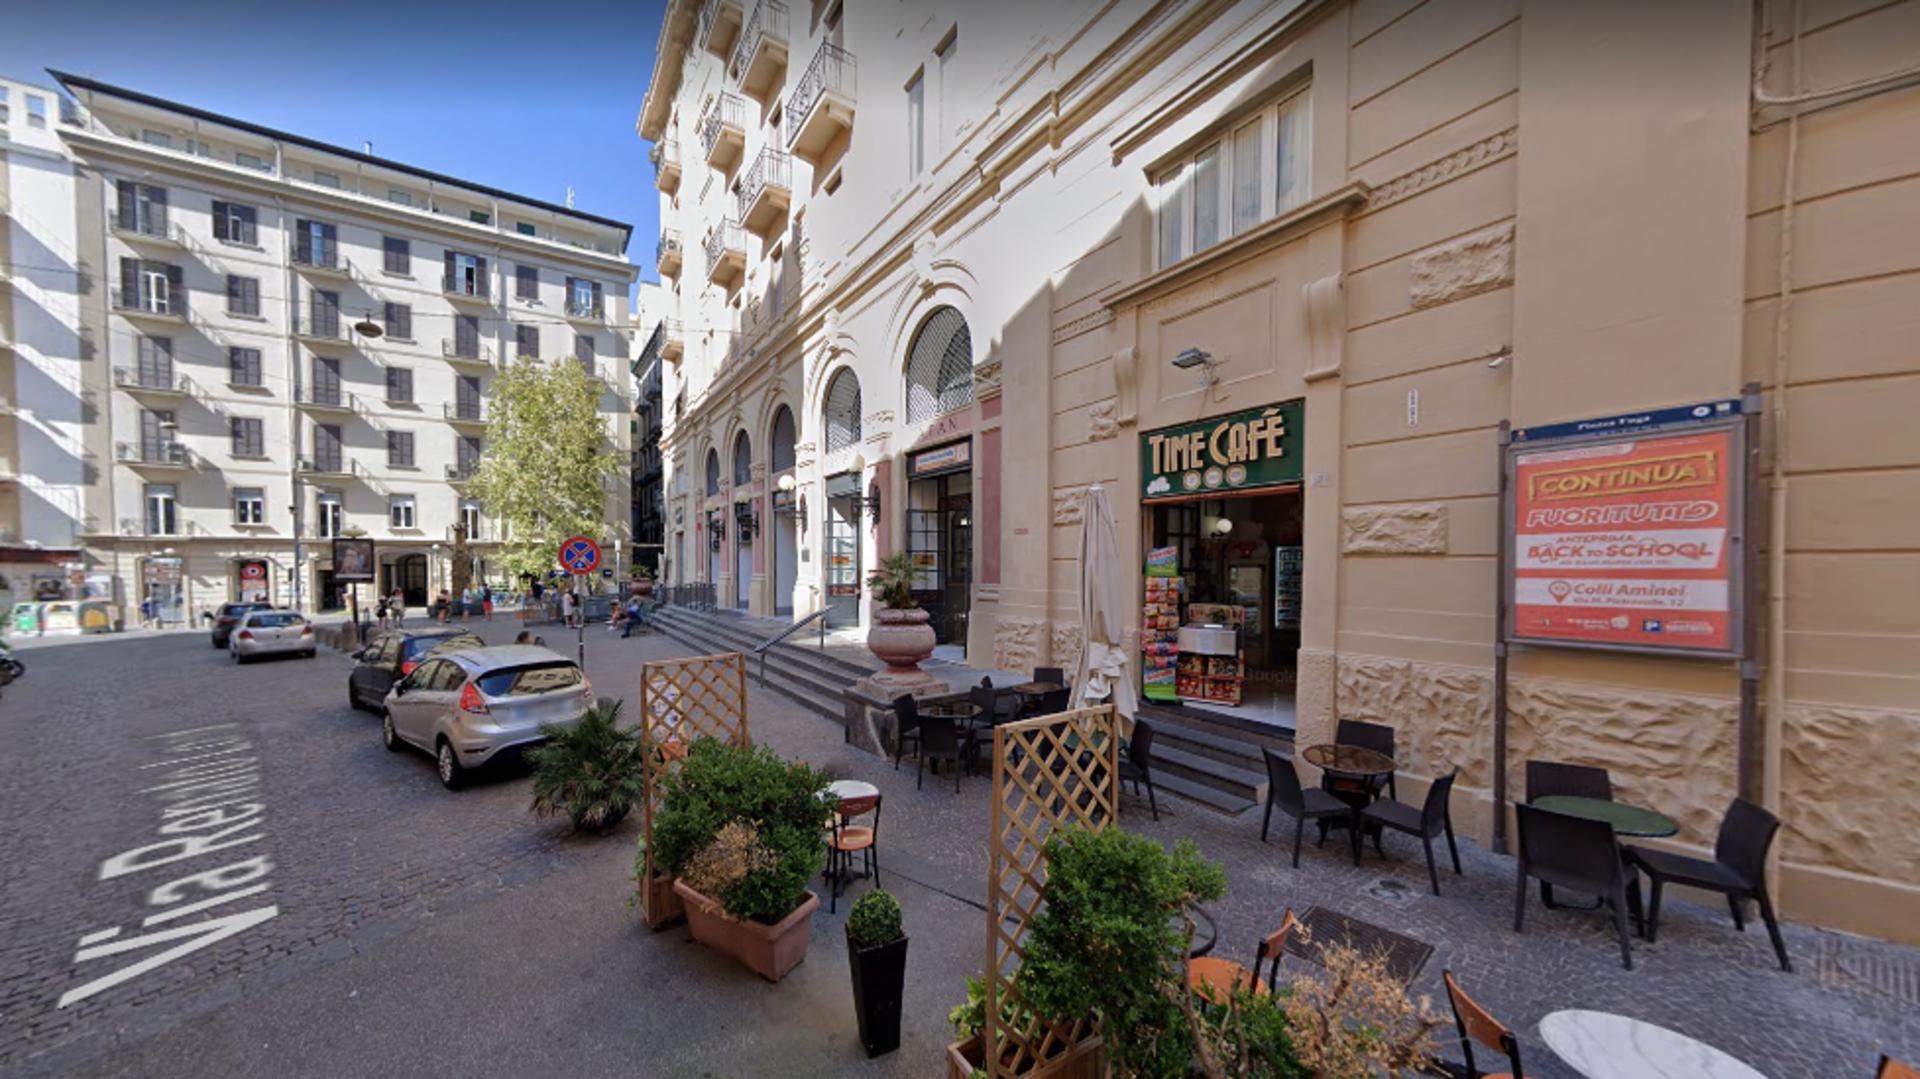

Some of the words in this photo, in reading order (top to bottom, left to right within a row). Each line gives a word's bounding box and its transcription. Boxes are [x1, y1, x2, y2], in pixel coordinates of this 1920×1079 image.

[1149, 431, 1206, 475] TIME
[1209, 408, 1285, 466] CAFÉ
[1526, 500, 1719, 529] FUORITUTTO
[1556, 533, 1636, 544] ANTEPRIMA
[1527, 544, 1583, 561] BACK
[1606, 542, 1714, 560] SCHOOL
[1573, 583, 1612, 595] Colli
